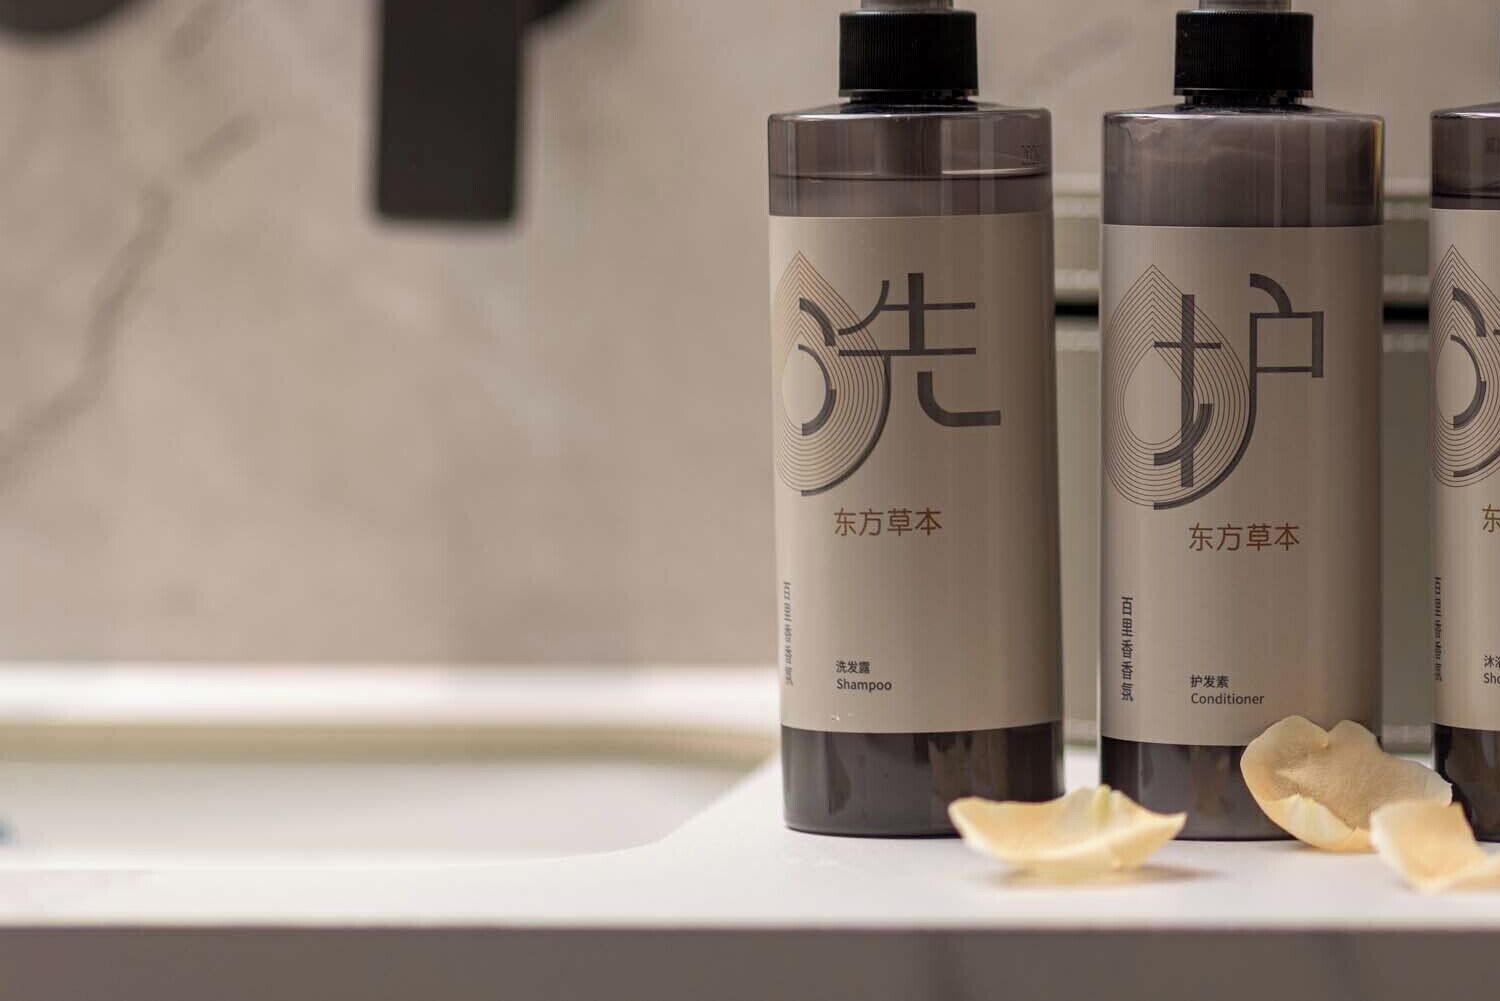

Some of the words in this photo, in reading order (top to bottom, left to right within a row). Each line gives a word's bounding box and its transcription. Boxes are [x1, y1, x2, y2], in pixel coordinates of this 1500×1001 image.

[1153, 272, 1324, 510] 护
[833, 507, 943, 537] 东方草本
[1188, 522, 1300, 551] 东方草本
[835, 660, 871, 674] 洗发露
[836, 678, 893, 693] Shampoo
[1190, 674, 1230, 689] 护发素
[1190, 692, 1265, 705] Conditioner
